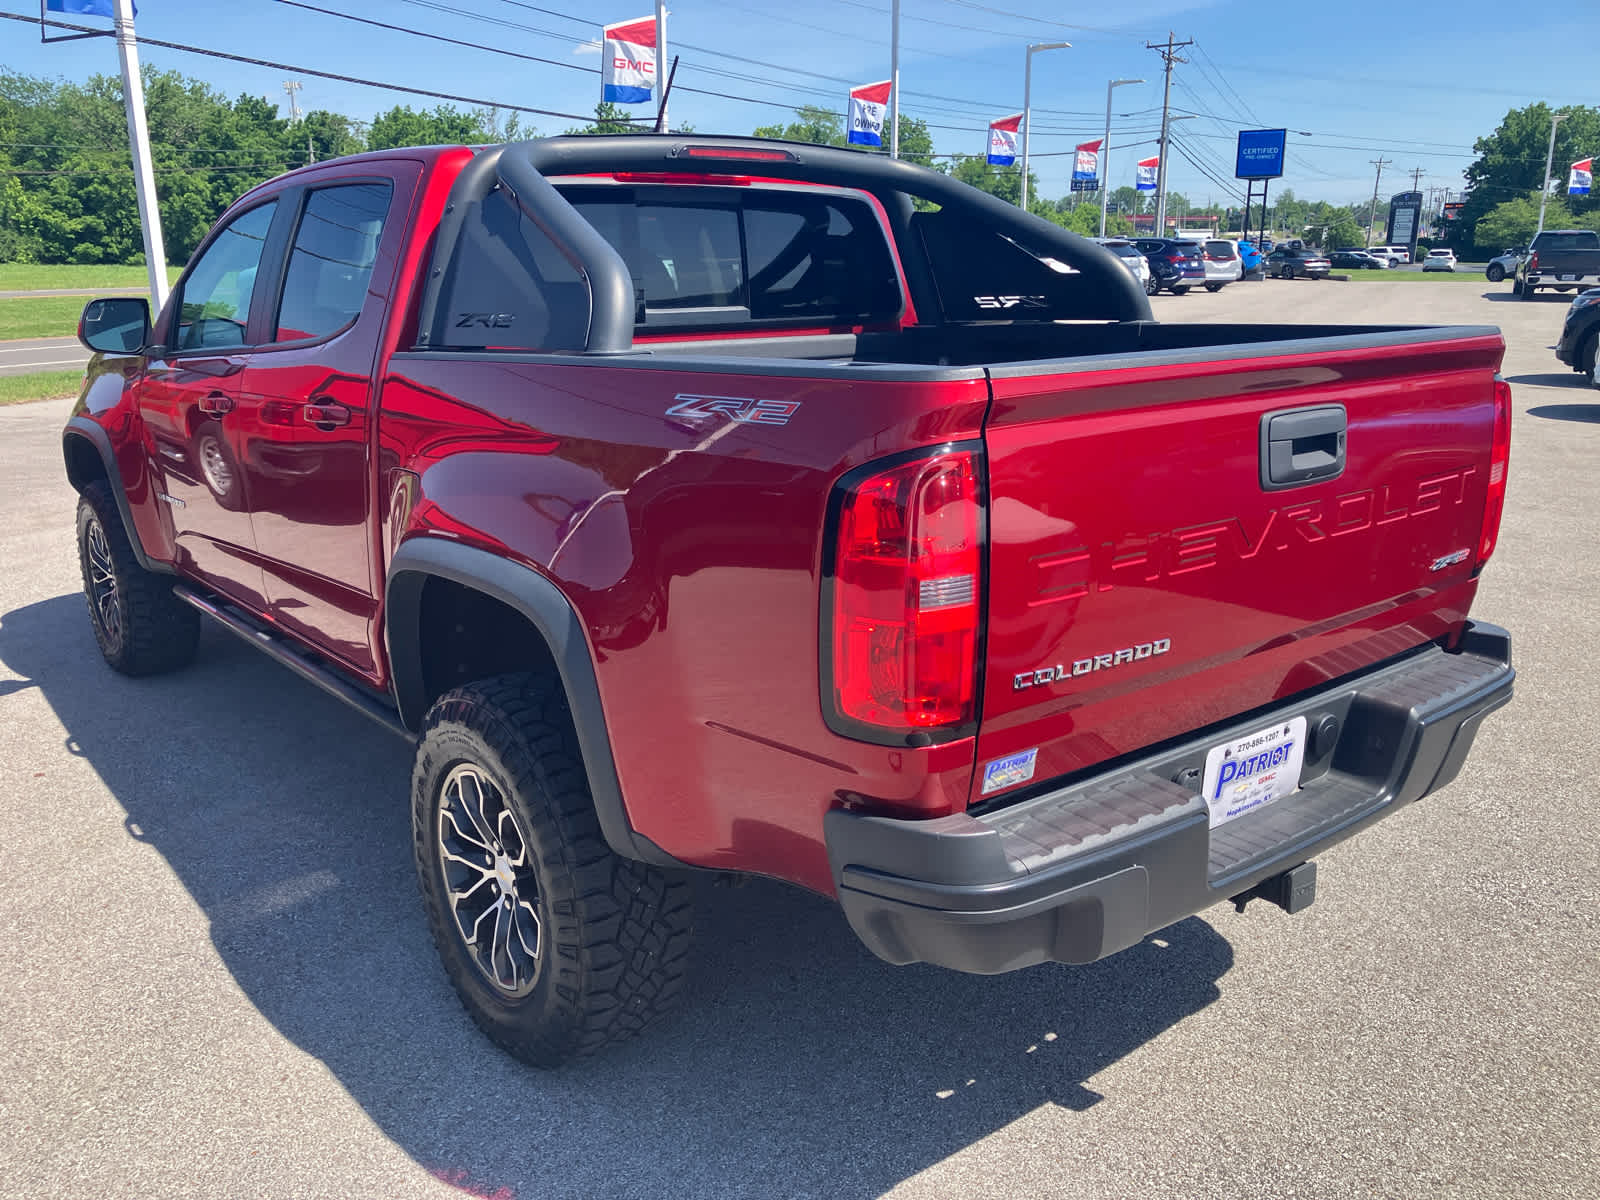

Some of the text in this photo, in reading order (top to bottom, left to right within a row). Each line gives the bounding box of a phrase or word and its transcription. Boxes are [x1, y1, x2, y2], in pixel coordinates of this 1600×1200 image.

[613, 57, 654, 73] GMC
[1242, 147, 1279, 155] CERTIFIED
[664, 393, 802, 426] ZR2
[1027, 465, 1477, 608] CHEVROLET
[1013, 637, 1172, 690] COLORADO
[1257, 772, 1277, 785] GMC
